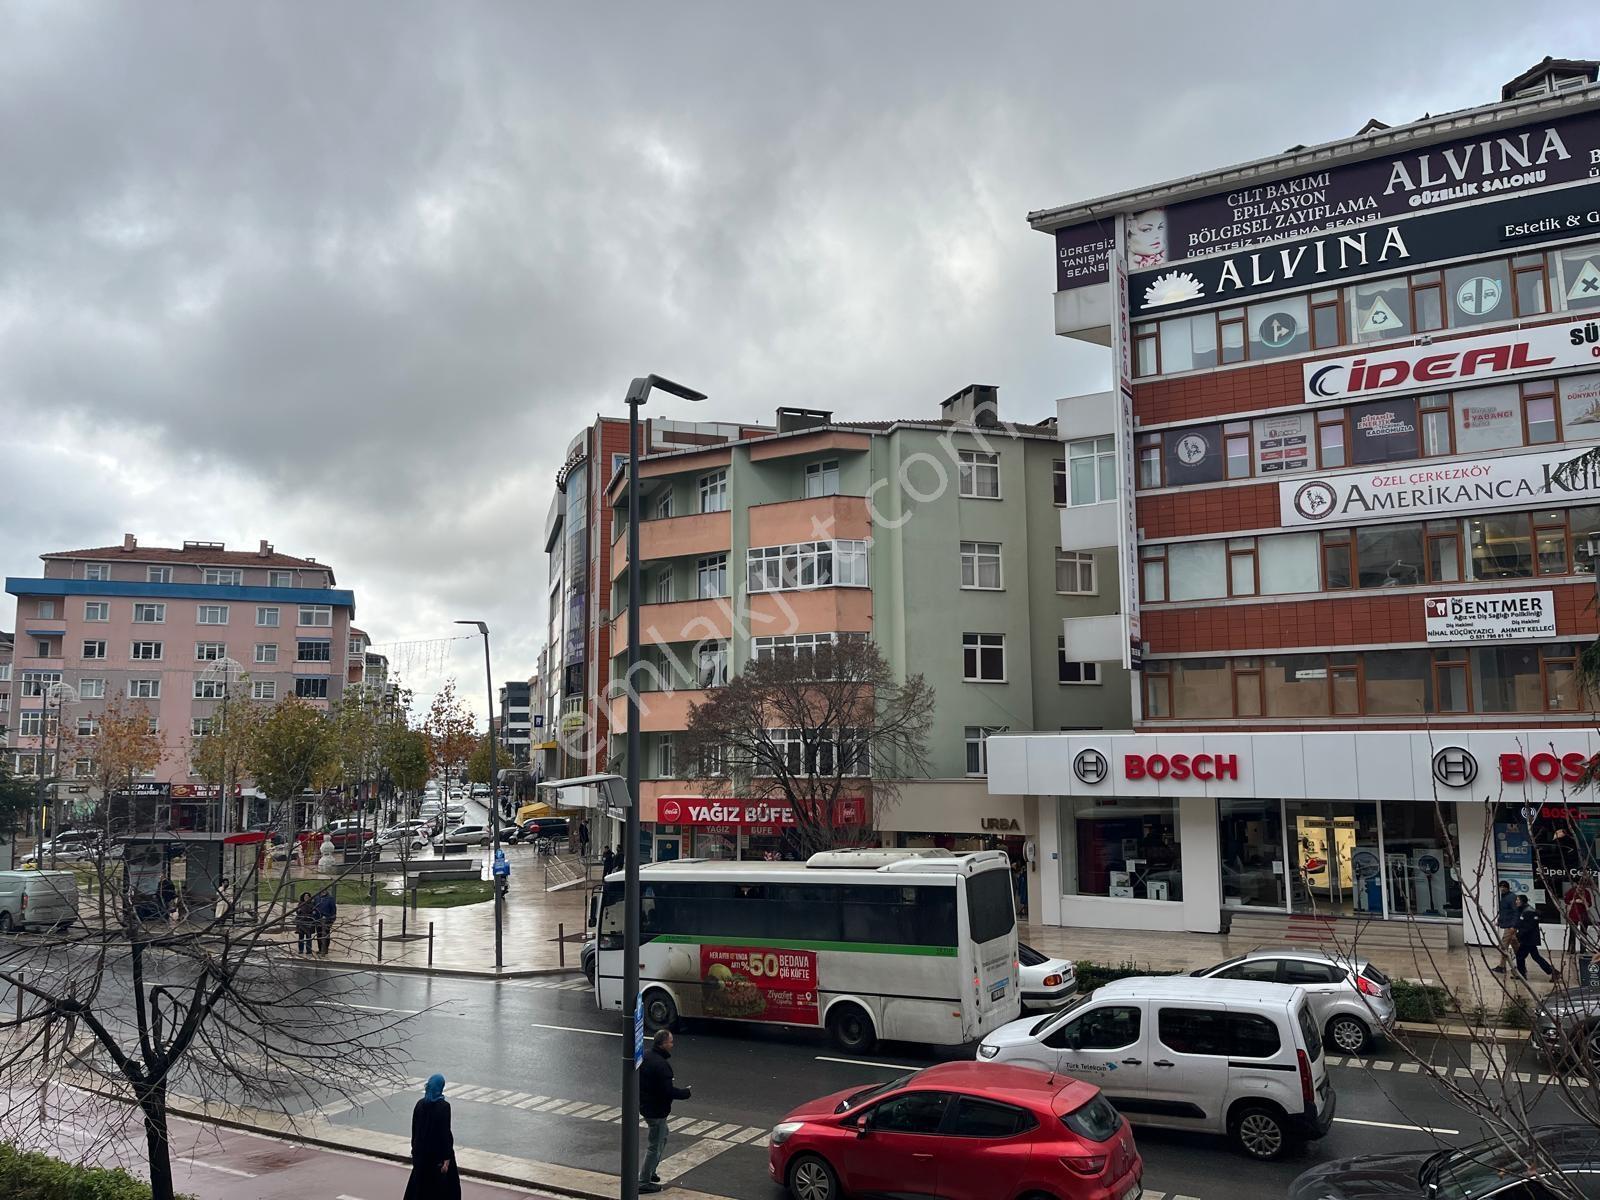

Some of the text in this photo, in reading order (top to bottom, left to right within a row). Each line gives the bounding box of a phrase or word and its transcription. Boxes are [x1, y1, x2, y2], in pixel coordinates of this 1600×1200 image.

[1383, 127, 1572, 196] ALVINA
[1265, 173, 1331, 200] BAKIMI
[1481, 170, 1547, 194] SALONU
[1188, 196, 1378, 247] BÖLGESEL ZAYIFLAMA
[1505, 218, 1561, 237] Estetik
[1059, 239, 1114, 258] ÜCRETSİZ
[1215, 226, 1411, 293] ALVINA
[1066, 262, 1109, 278] SEANSI
[1372, 465, 1492, 488] ÖZEL ÇERKEZKÖY
[1341, 478, 1534, 514] AMERİKANCA
[1451, 597, 1543, 615] DENTMER
[1428, 628, 1494, 637] NİHAL KÜÇÜKYAZICI
[1527, 624, 1554, 632] KELLECİ
[1125, 754, 1238, 780] BOSCH
[1499, 753, 1600, 783] BOS
[688, 803, 740, 822] YAĞIZ
[744, 803, 794, 823] BÜFE
[981, 817, 1020, 831] URBA
[1536, 867, 1566, 877] Süper
[779, 954, 809, 968] BEDAVA
[779, 967, 810, 979] ÇİĞ KÖFTE
[1081, 1063, 1106, 1072] Telekom
